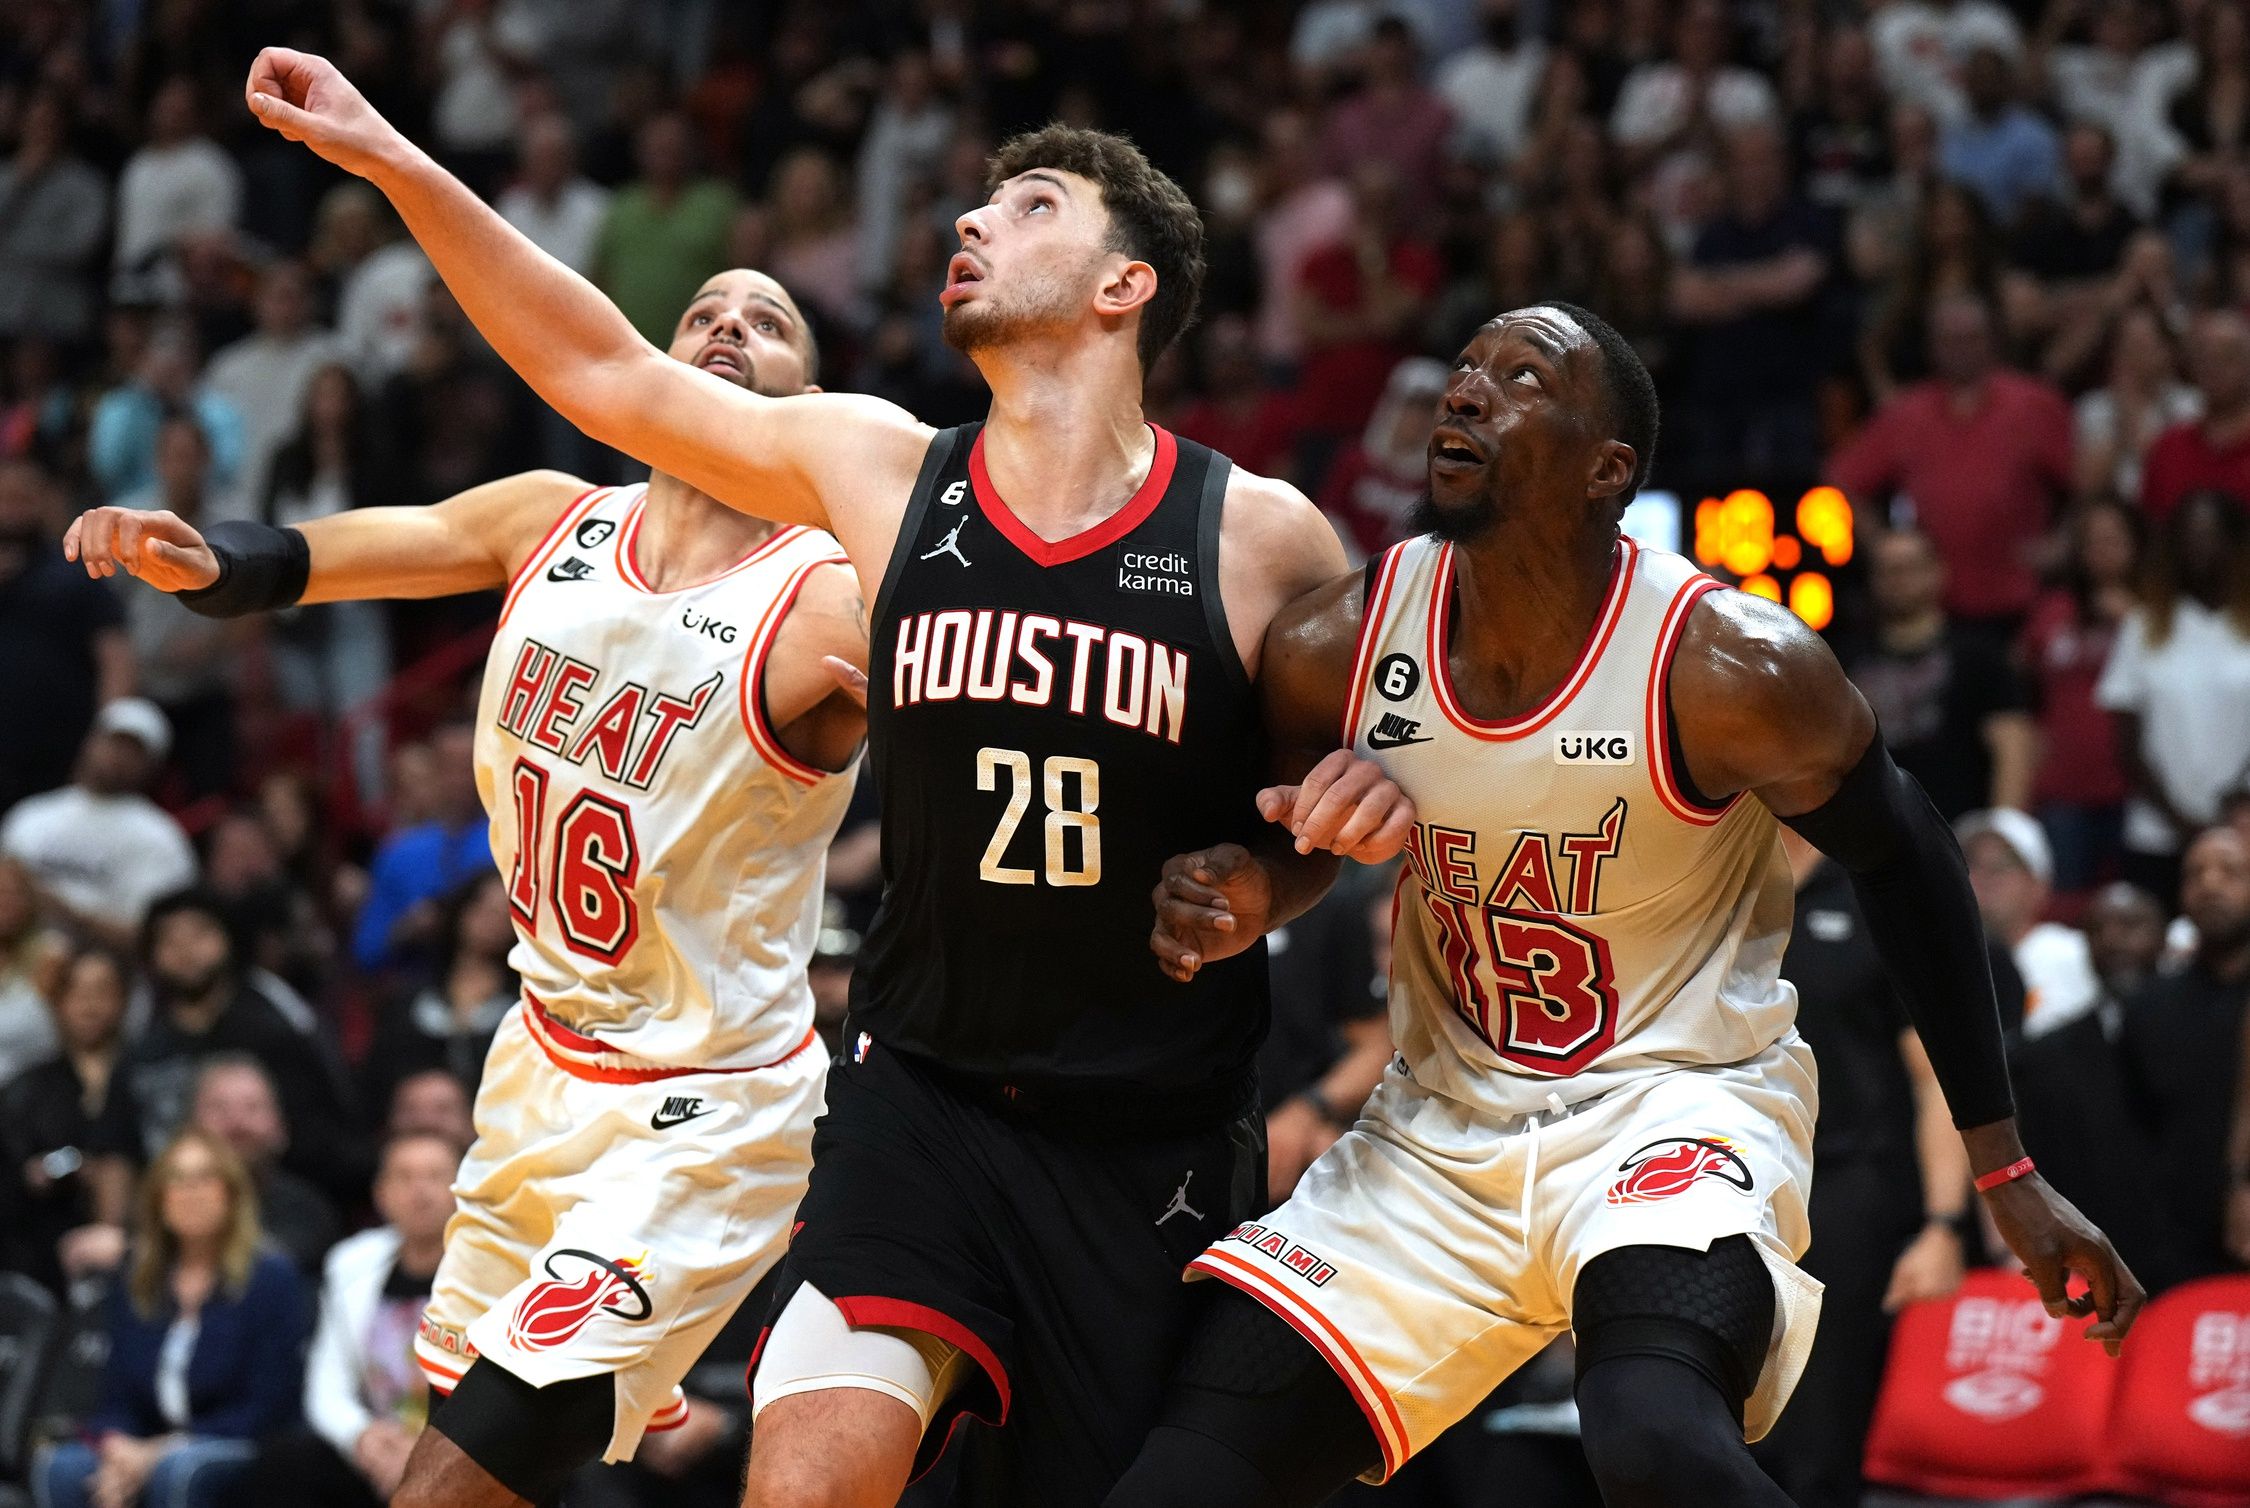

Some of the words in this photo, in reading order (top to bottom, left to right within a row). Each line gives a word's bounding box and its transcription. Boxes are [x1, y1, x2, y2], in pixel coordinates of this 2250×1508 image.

[941, 480, 967, 505] 6
[580, 522, 613, 547] 6
[1123, 552, 1189, 575] credit
[1118, 567, 1193, 596] karma
[894, 608, 1190, 745] HOUSTON
[1384, 660, 1411, 696] 6
[498, 637, 724, 791] HEAT
[1376, 712, 1421, 741] NIKE
[977, 747, 1101, 886] 28
[510, 756, 640, 967] 16
[1421, 885, 1620, 1077] 13
[660, 1096, 703, 1119] NIKE
